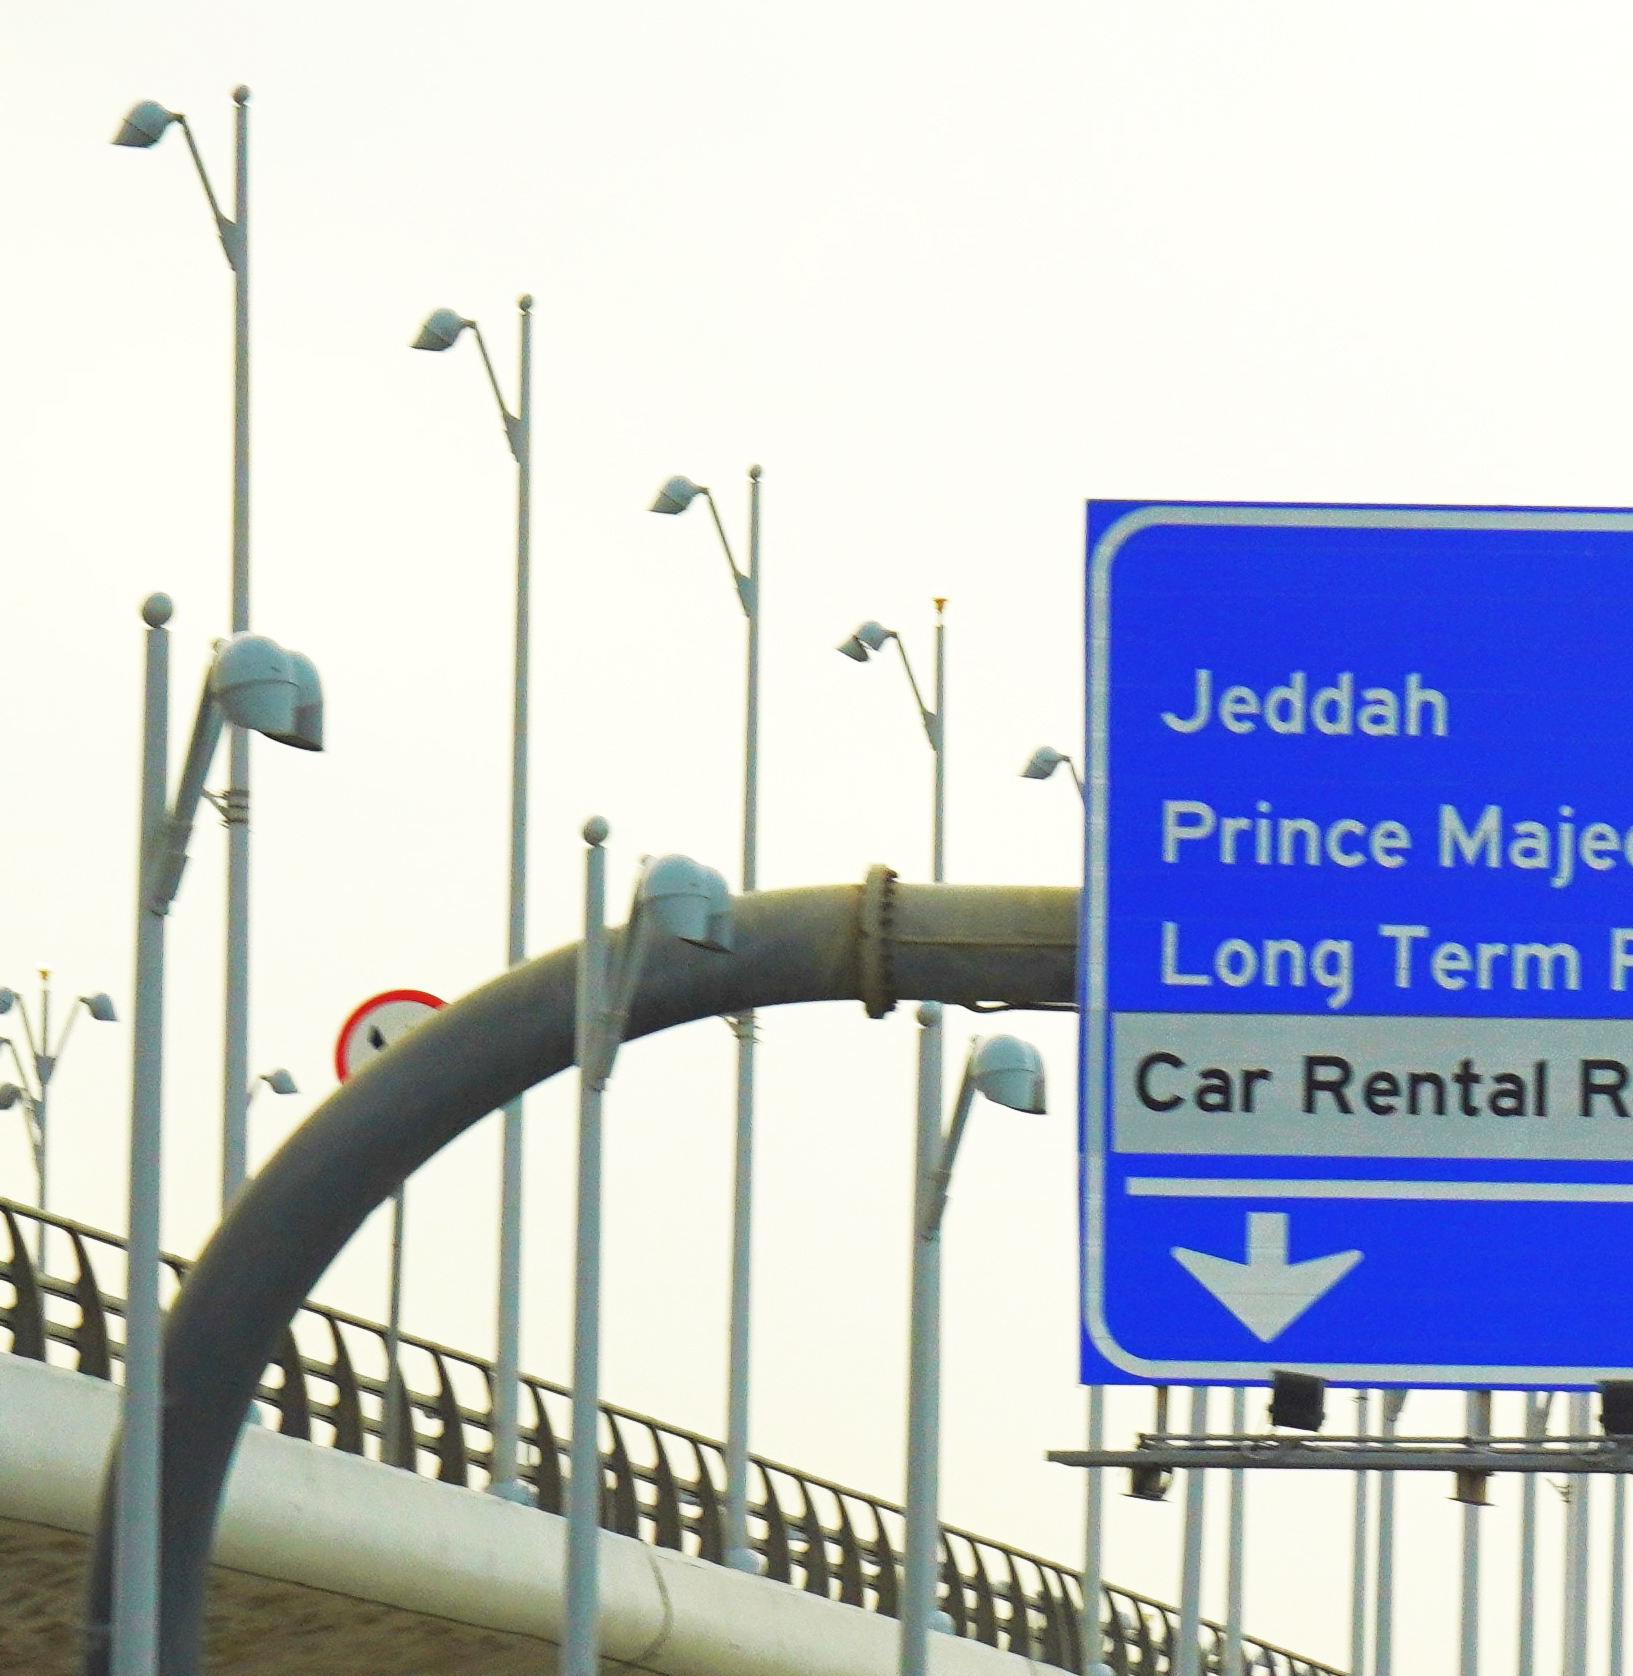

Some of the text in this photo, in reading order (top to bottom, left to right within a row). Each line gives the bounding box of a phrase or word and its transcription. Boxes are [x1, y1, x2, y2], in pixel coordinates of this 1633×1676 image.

[1161, 669, 1449, 737] Jeddah
[1162, 799, 1412, 869] Prince
[1161, 921, 1354, 1010] Long
[1379, 924, 1580, 991] Term
[1134, 1050, 1272, 1114] Car
[1300, 1054, 1549, 1118] Rental
